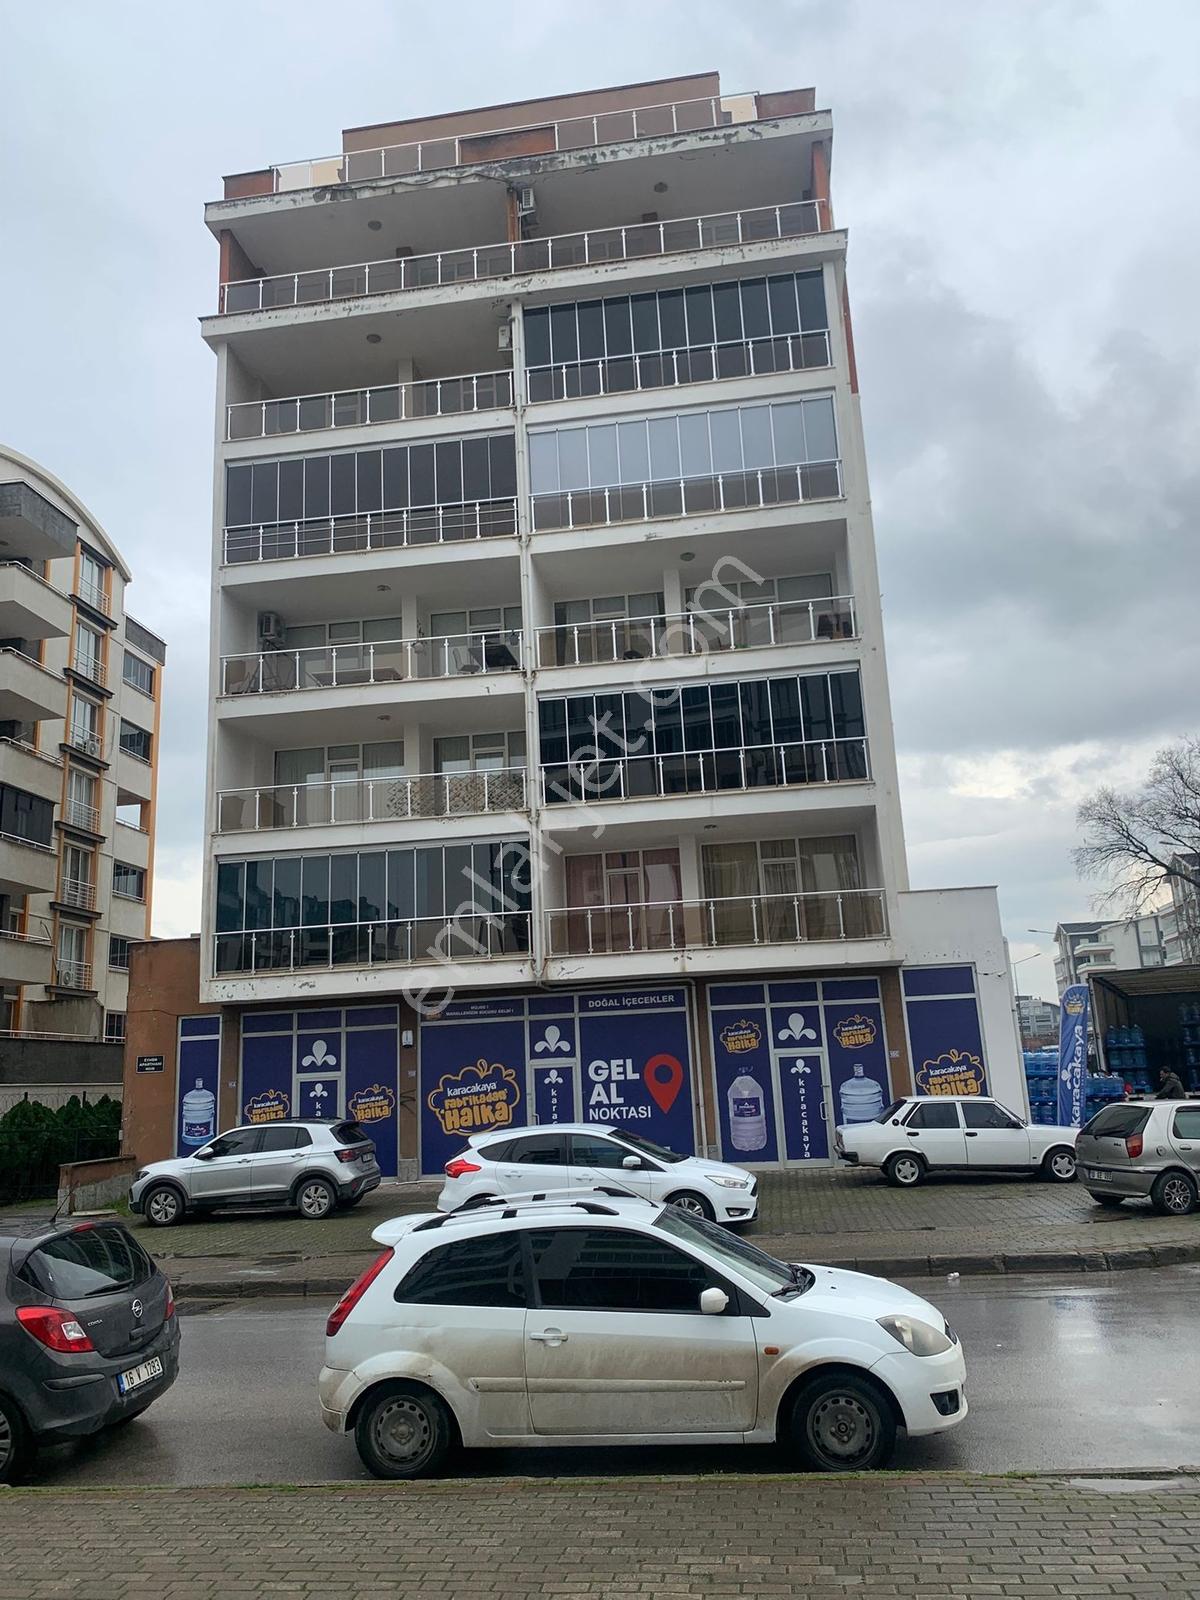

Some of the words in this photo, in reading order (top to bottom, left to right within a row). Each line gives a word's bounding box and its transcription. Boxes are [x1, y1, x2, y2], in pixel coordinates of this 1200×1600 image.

[588, 998, 620, 1008] DOĞAL
[622, 994, 675, 1007] İÇECEKLER
[727, 1037, 757, 1051] Halka
[841, 1033, 872, 1047] Halka
[588, 1058, 640, 1082] GEL
[929, 1064, 967, 1076] karacakaya
[1070, 1025, 1085, 1127] karacakaya
[447, 1082, 497, 1097] karacakaya
[589, 1083, 624, 1105] AL
[929, 1078, 977, 1096] Halka
[356, 1104, 390, 1122] Halka
[444, 1101, 509, 1131] Halka
[589, 1106, 651, 1121] NOKTASI
[798, 1077, 811, 1158] karacakaya
[125, 1371, 135, 1387] 16
[135, 1367, 141, 1381] V
